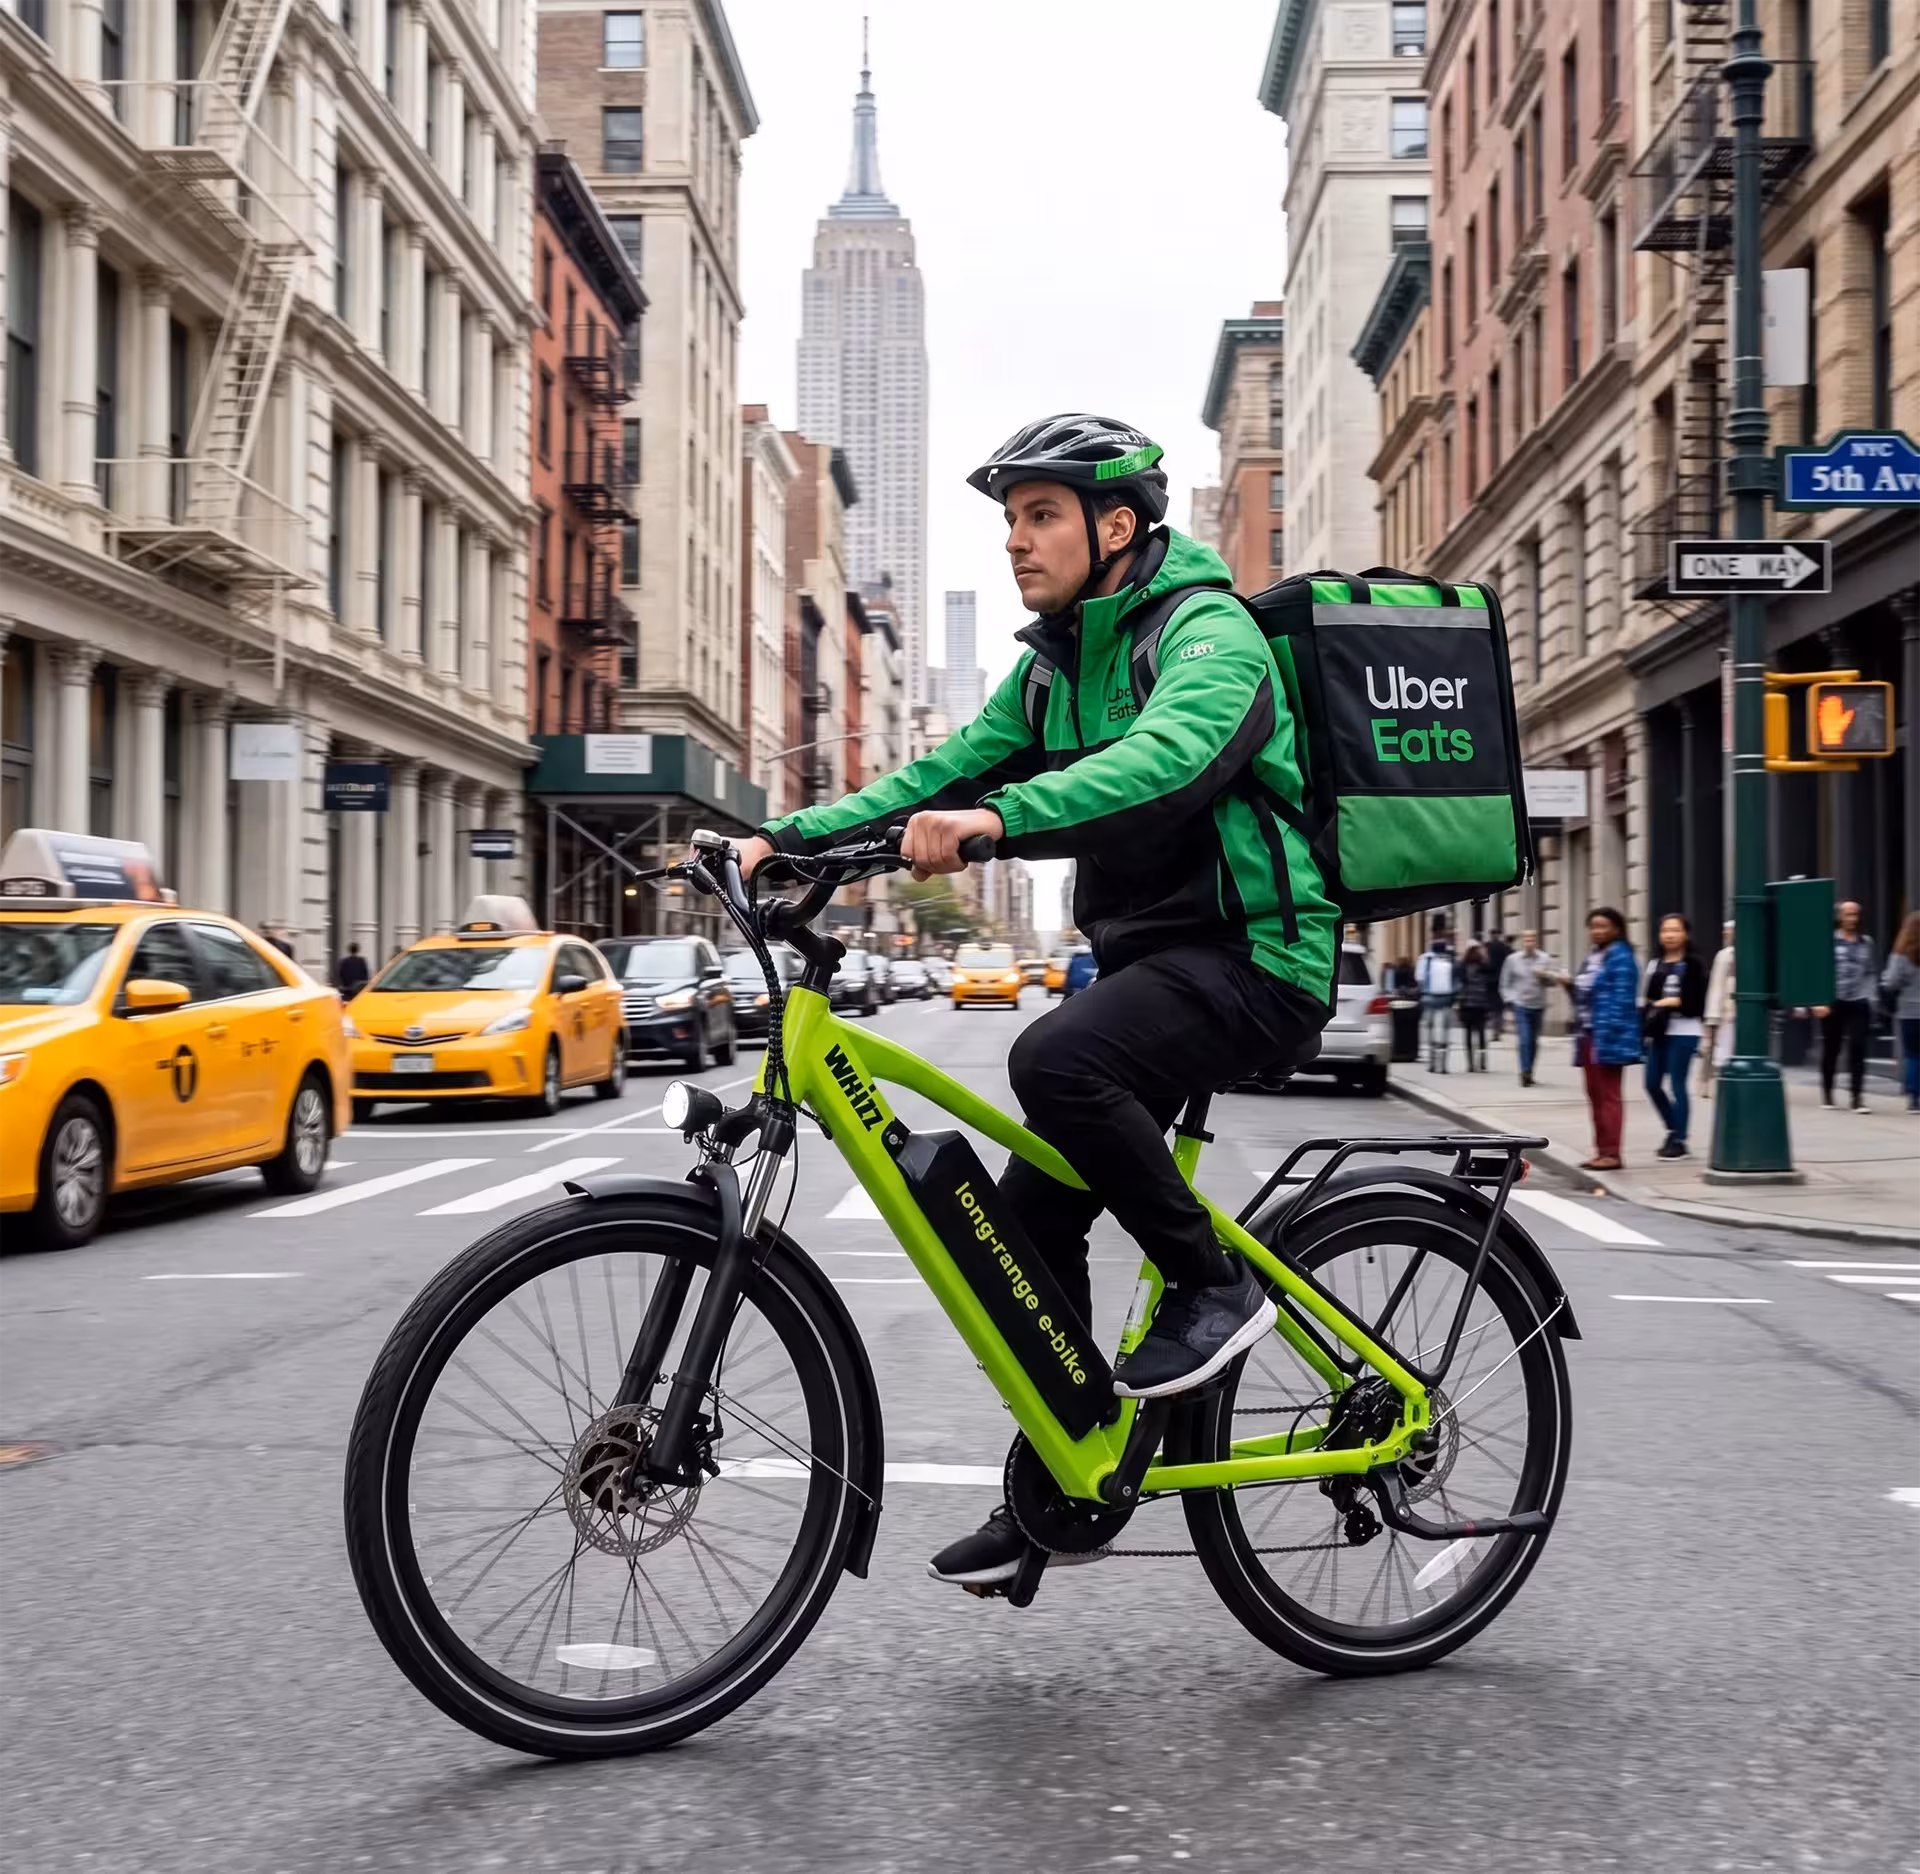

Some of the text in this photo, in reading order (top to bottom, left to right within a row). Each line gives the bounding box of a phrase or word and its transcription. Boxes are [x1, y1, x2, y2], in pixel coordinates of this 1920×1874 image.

[1850, 443, 1894, 457] NYC
[1811, 465, 1920, 491] 5th Av
[1694, 557, 1802, 576] ONE WAY
[1365, 666, 1468, 710] Uber
[1107, 703, 1139, 722] Eats
[1371, 718, 1474, 762] Eats
[955, 1181, 1086, 1385] long-range e-bike
